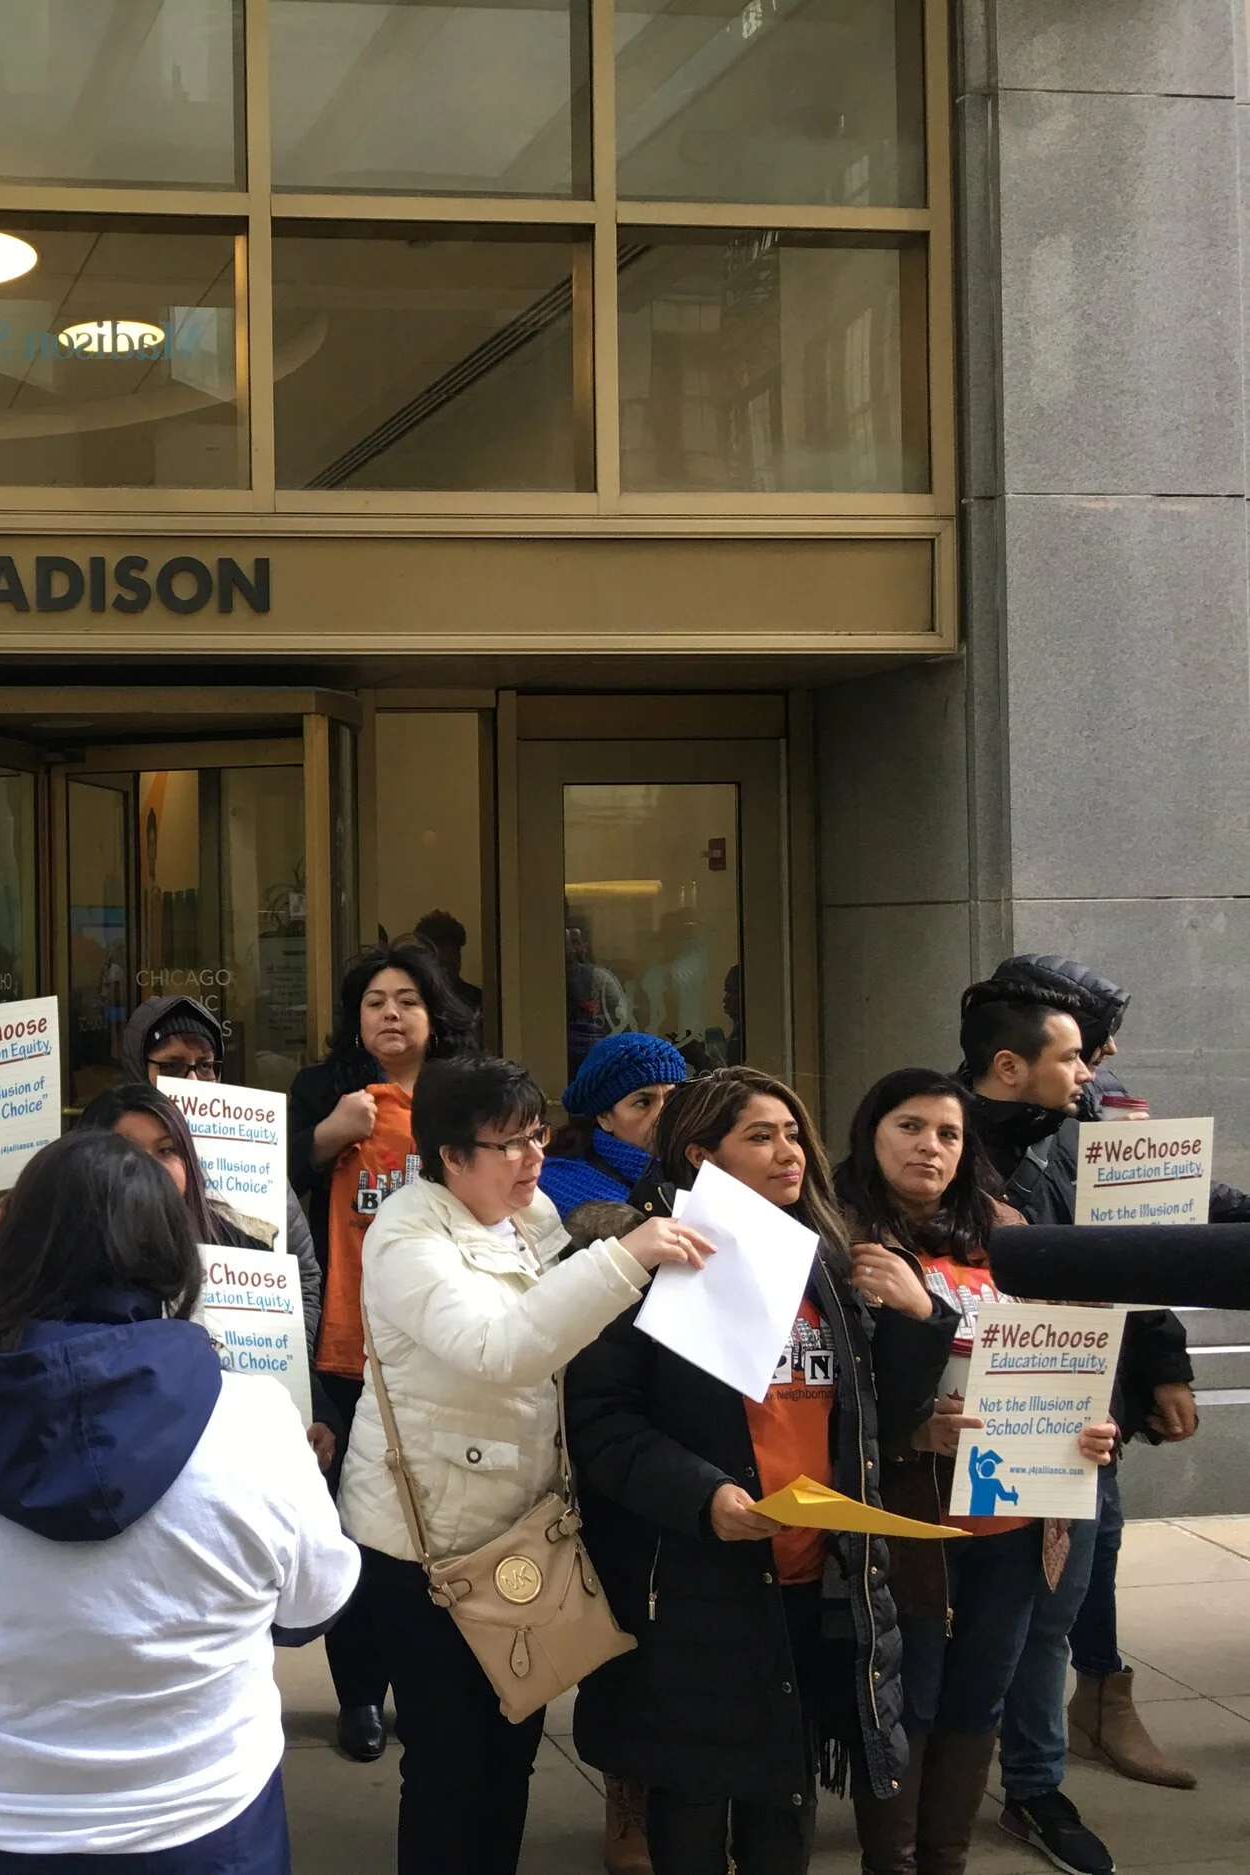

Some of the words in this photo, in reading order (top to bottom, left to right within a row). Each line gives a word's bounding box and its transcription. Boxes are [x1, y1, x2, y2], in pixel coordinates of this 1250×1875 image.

[135, 969, 232, 987] CHICAGO
[33, 1076, 46, 1092] of
[186, 1119, 236, 1136] ucation
[1085, 1137, 1202, 1164] #WeChoose
[216, 1158, 257, 1173] Illusion
[259, 1162, 271, 1175] of
[1097, 1164, 1161, 1182] Education
[1090, 1207, 1114, 1222] Not
[1117, 1204, 1137, 1219] the
[1140, 1201, 1179, 1217] Illusion
[1181, 1198, 1194, 1213] of
[202, 1262, 287, 1289] Choose
[206, 1290, 244, 1305] ation
[224, 1330, 273, 1348] Illusion
[275, 1334, 288, 1350] of
[981, 1323, 1109, 1348] #WeChoose
[809, 1356, 831, 1379] N
[990, 1352, 1057, 1369] Education
[979, 1398, 1002, 1412] Not
[1006, 1397, 1026, 1411] the
[1029, 1396, 1074, 1411] Illusion
[1076, 1396, 1092, 1411] of
